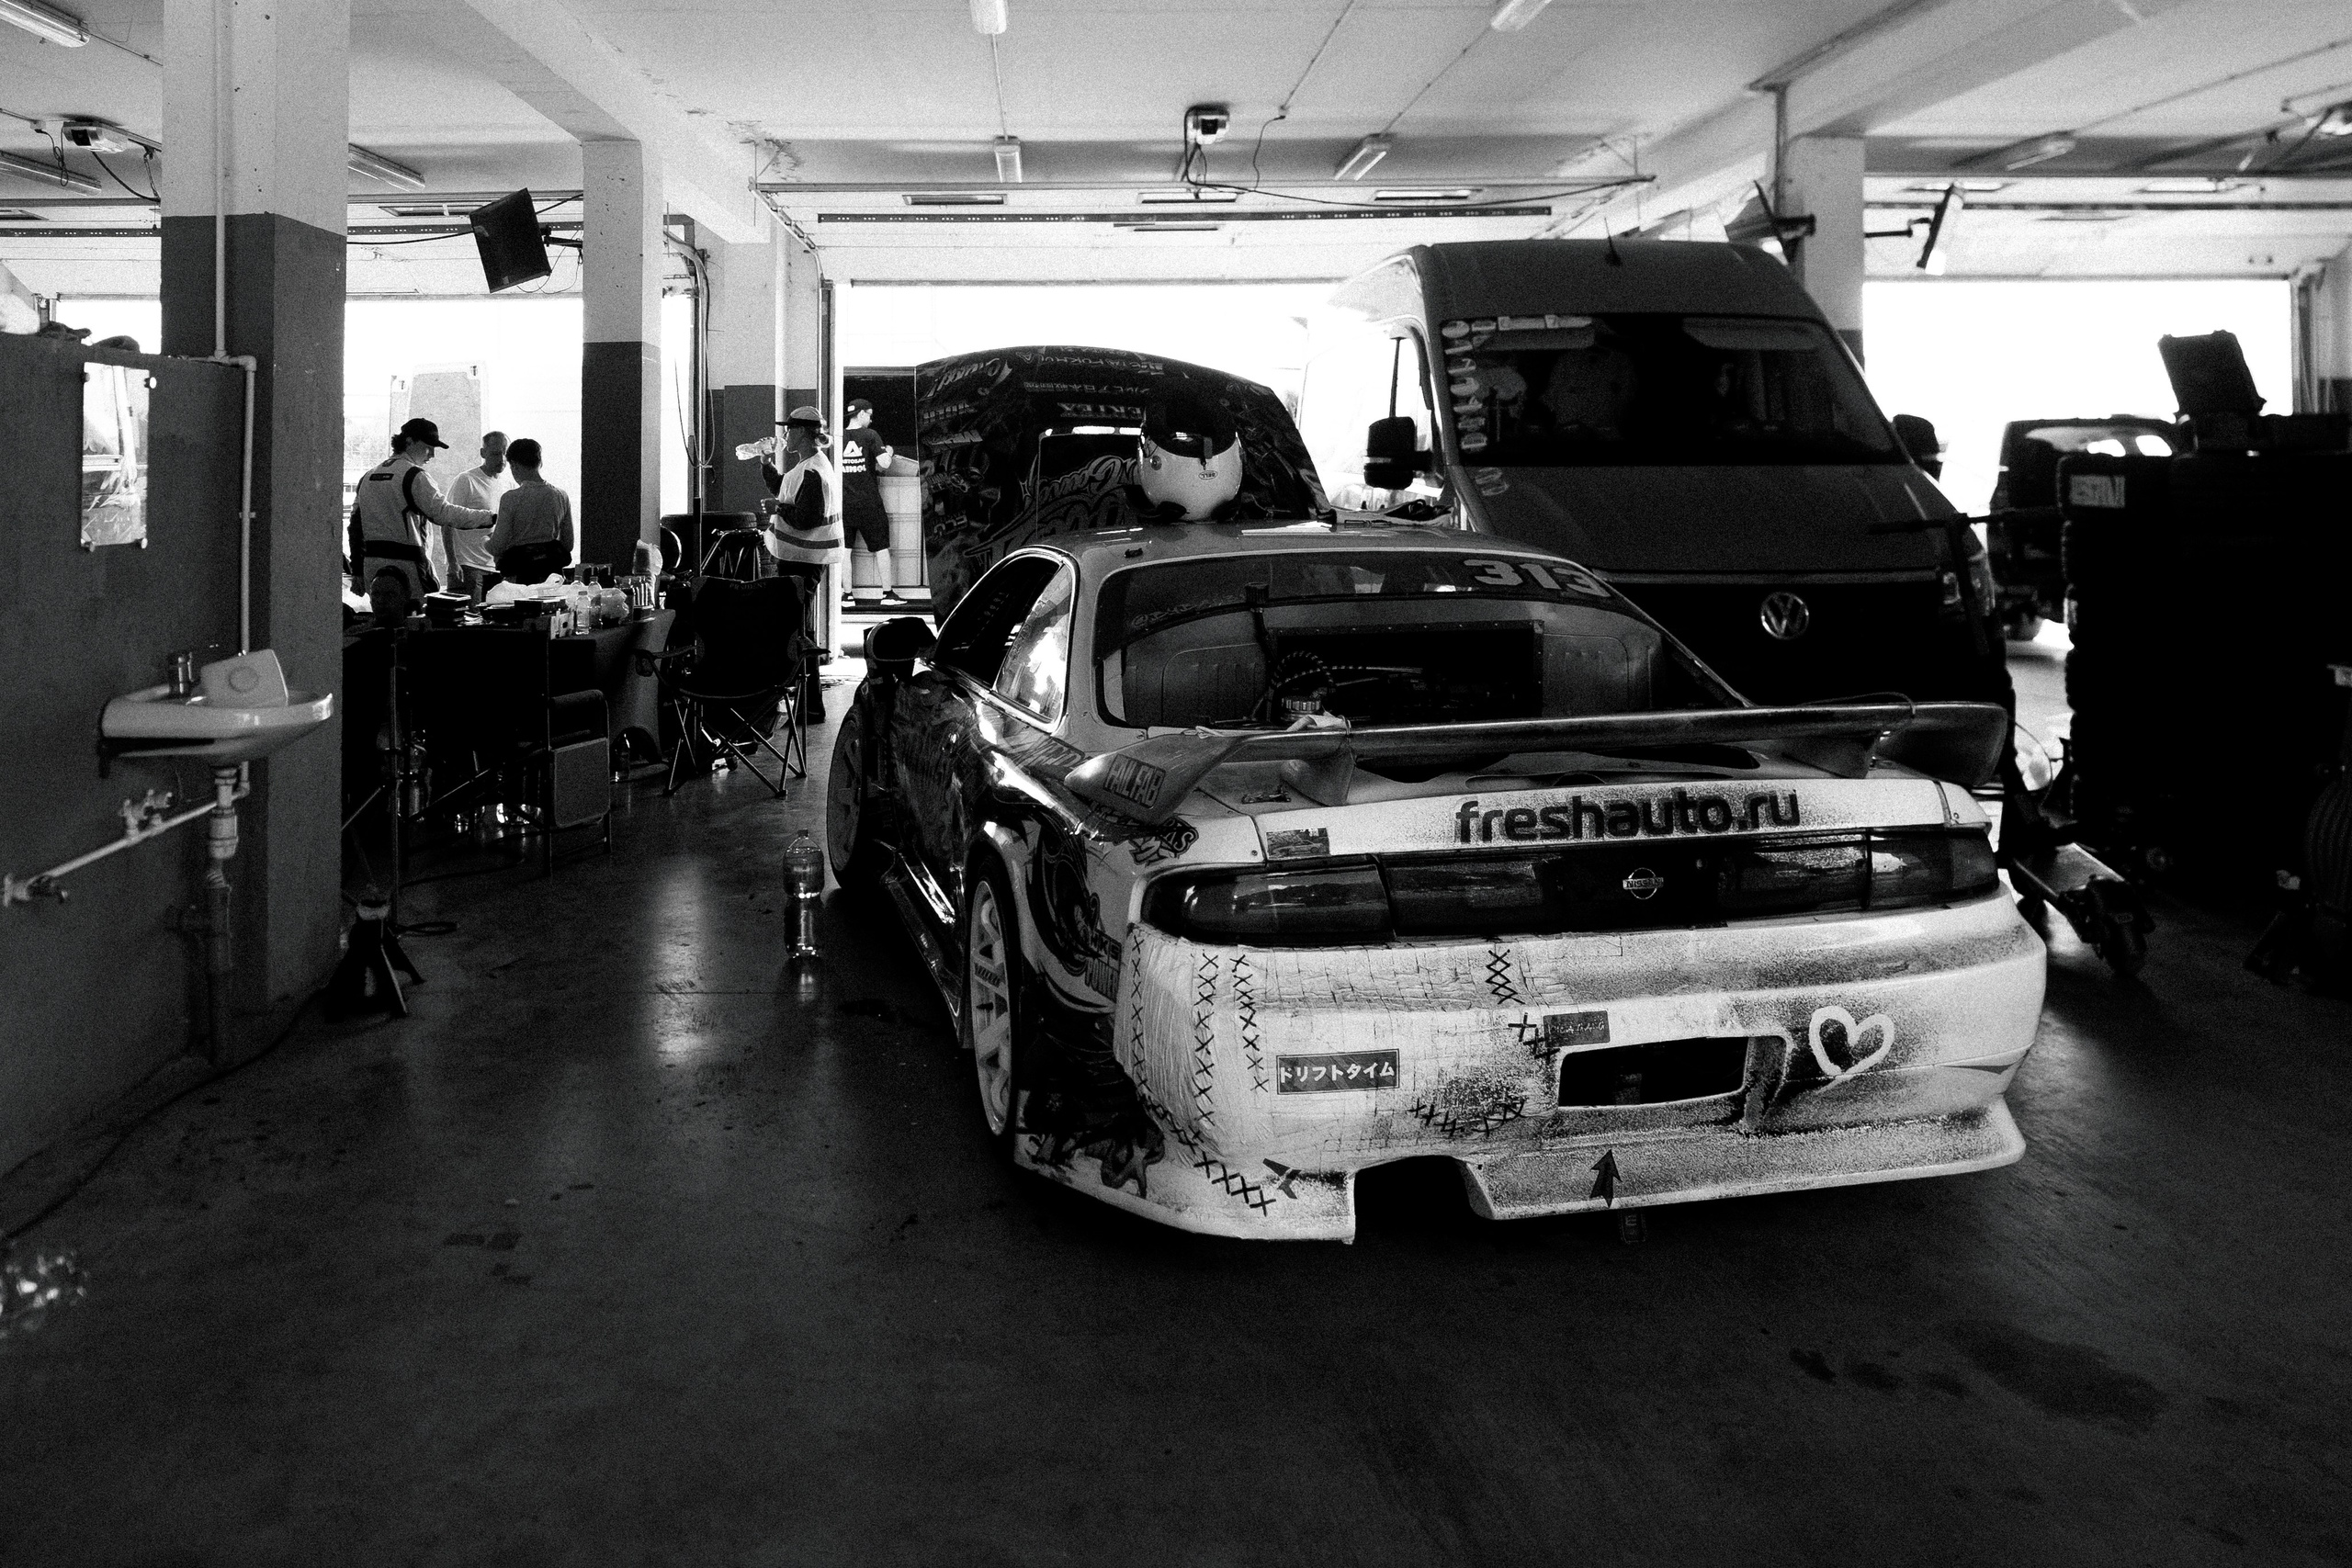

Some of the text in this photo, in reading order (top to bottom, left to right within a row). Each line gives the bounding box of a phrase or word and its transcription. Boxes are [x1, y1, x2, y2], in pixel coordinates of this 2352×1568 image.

[1464, 559, 1611, 597] 313
[1456, 789, 1800, 843] freshauto.ru
[1624, 877, 1663, 889] NISSAN
[1280, 1061, 1395, 1084] ドリフトタイム
